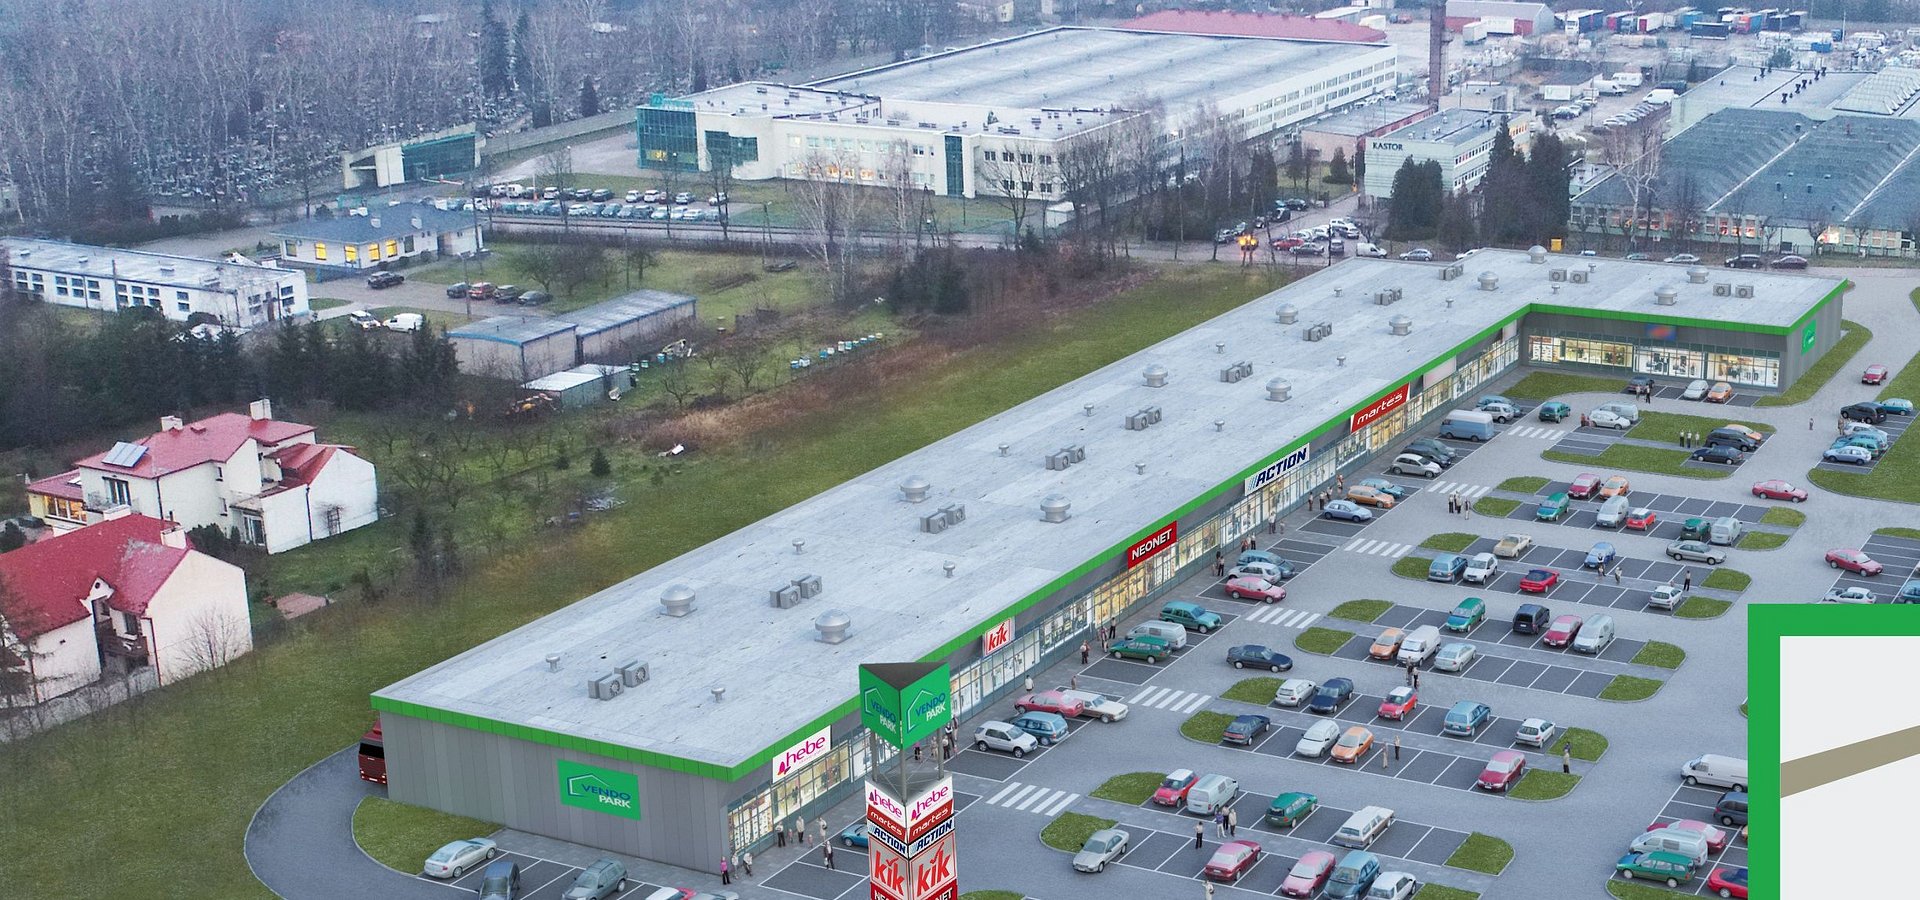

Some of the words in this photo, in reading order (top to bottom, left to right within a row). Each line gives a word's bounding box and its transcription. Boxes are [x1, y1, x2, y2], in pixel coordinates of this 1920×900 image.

[1372, 142, 1403, 151] KASTOR
[1357, 393, 1403, 425] martes
[1255, 447, 1307, 488] ACTION
[1132, 528, 1173, 561] NEONET
[871, 699, 896, 724] VENDO
[915, 692, 946, 717] VENDO
[926, 701, 946, 722] PARK
[879, 714, 897, 734] PARK
[786, 736, 826, 768] hebe
[582, 783, 631, 801] VENDO
[599, 794, 631, 809] PARK
[874, 788, 903, 818] hebe
[916, 786, 949, 814] hebe
[870, 811, 903, 836] martes
[912, 807, 949, 836] martes
[916, 819, 953, 851] ACTION
[873, 826, 906, 854] ACTION
